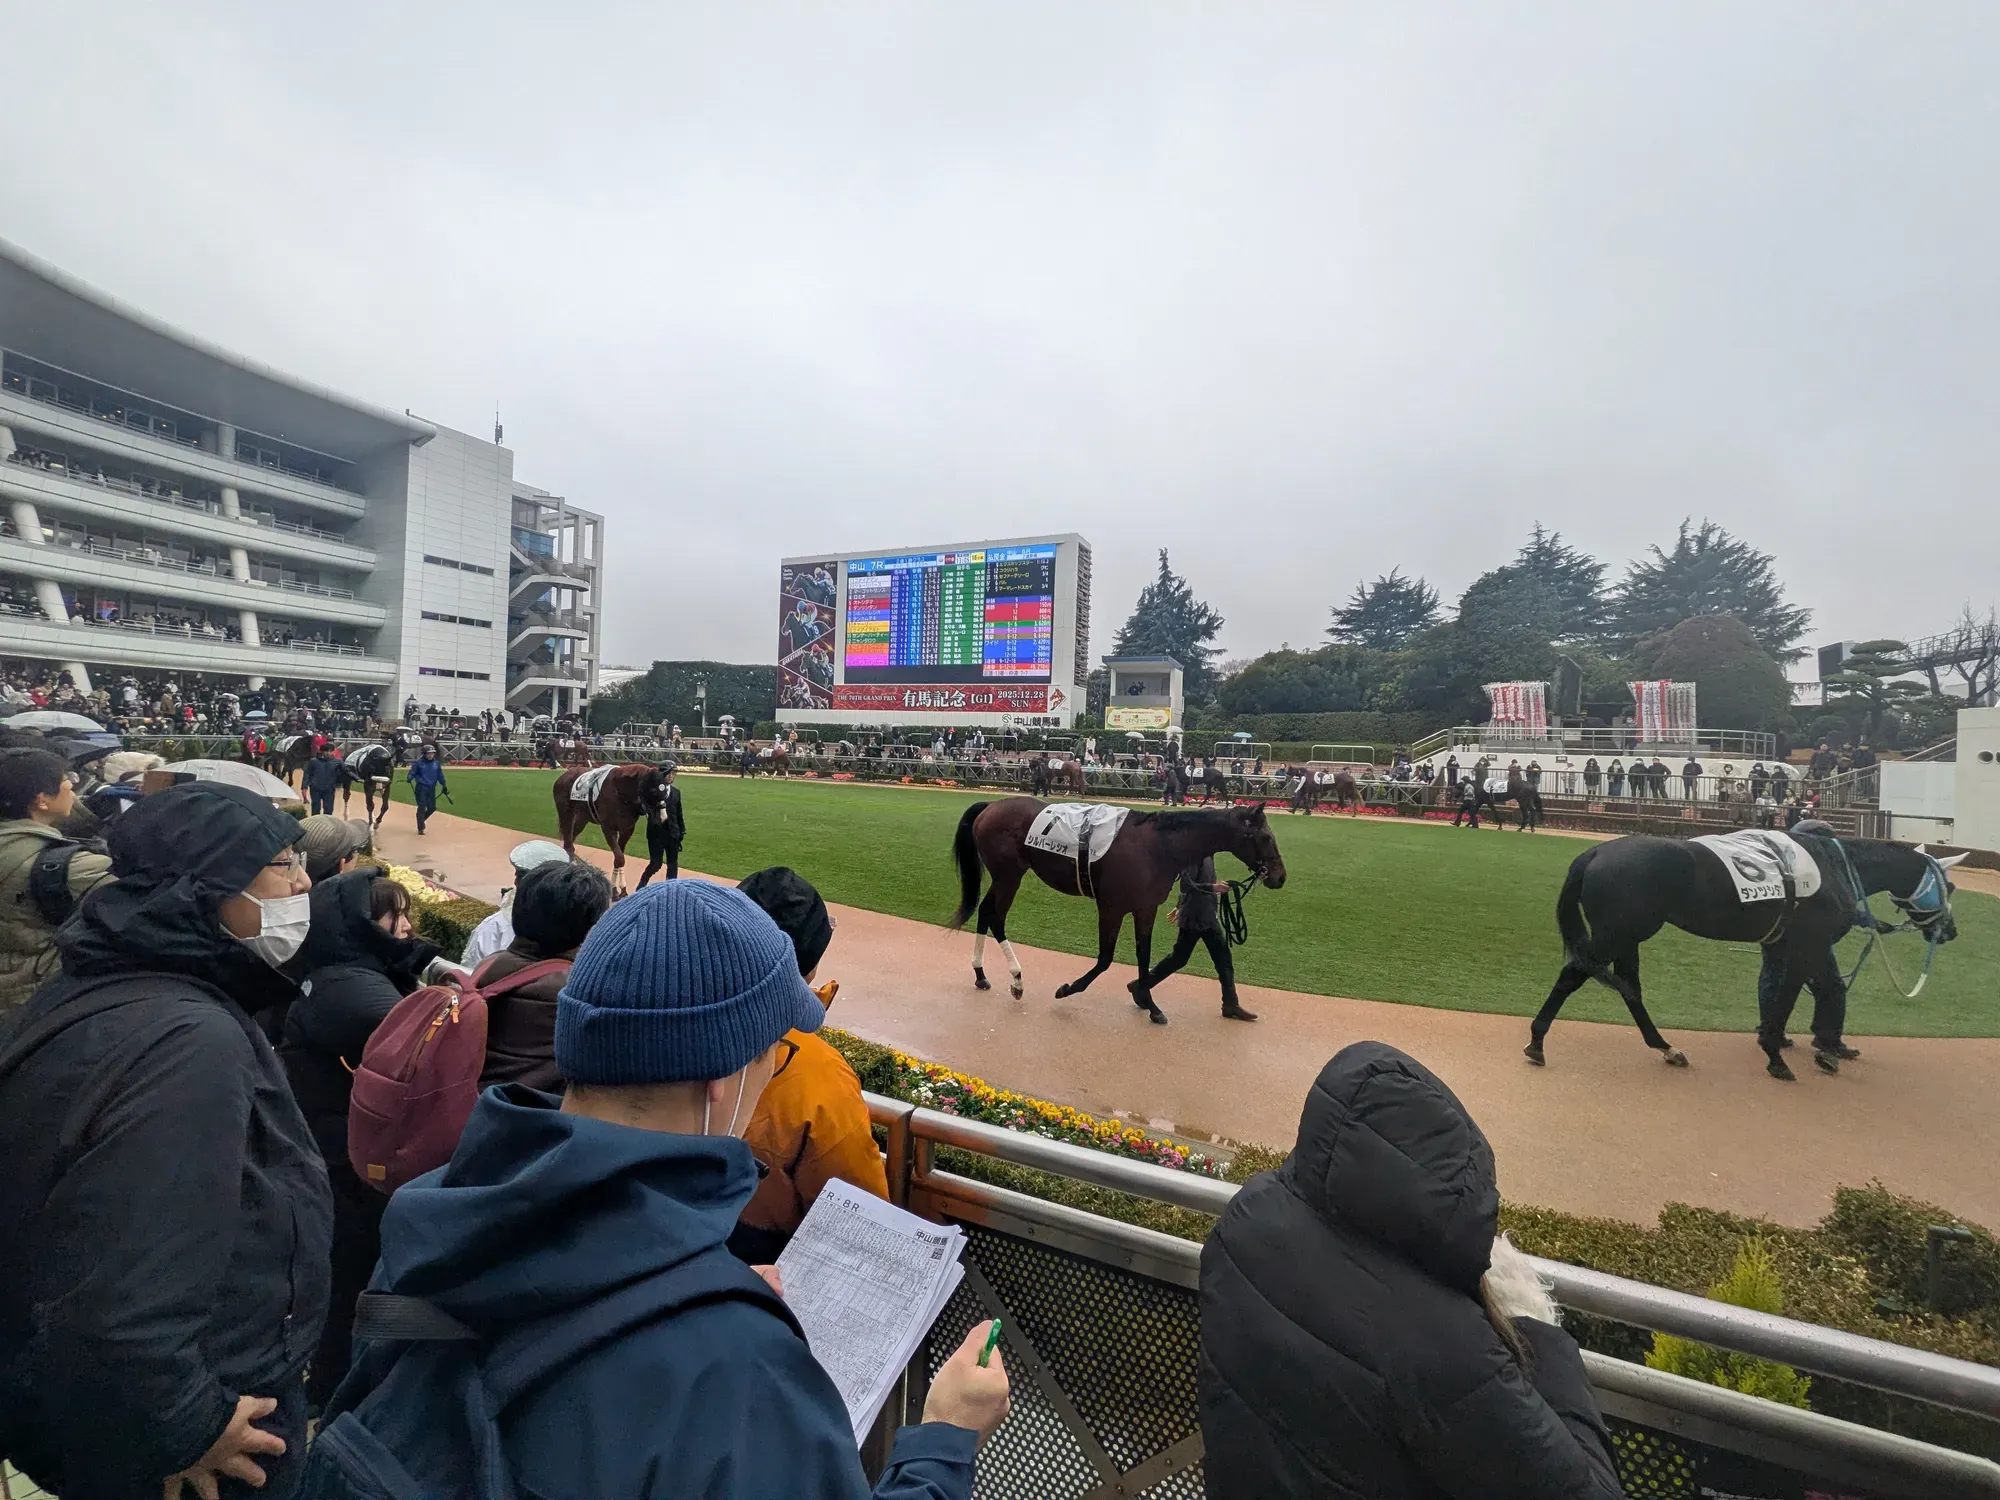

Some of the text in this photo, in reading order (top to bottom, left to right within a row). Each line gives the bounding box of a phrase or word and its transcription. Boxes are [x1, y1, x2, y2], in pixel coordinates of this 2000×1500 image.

[850, 563, 866, 571] 中山
[871, 561, 884, 570] 7R
[902, 689, 966, 708] 有馬記念
[997, 690, 1044, 699] 2025.12.28
[1011, 700, 1029, 708] SUN
[1013, 716, 1061, 728] 中山競馬場
[1027, 834, 1069, 855] シルバーレシオ
[1731, 851, 1767, 883] 6
